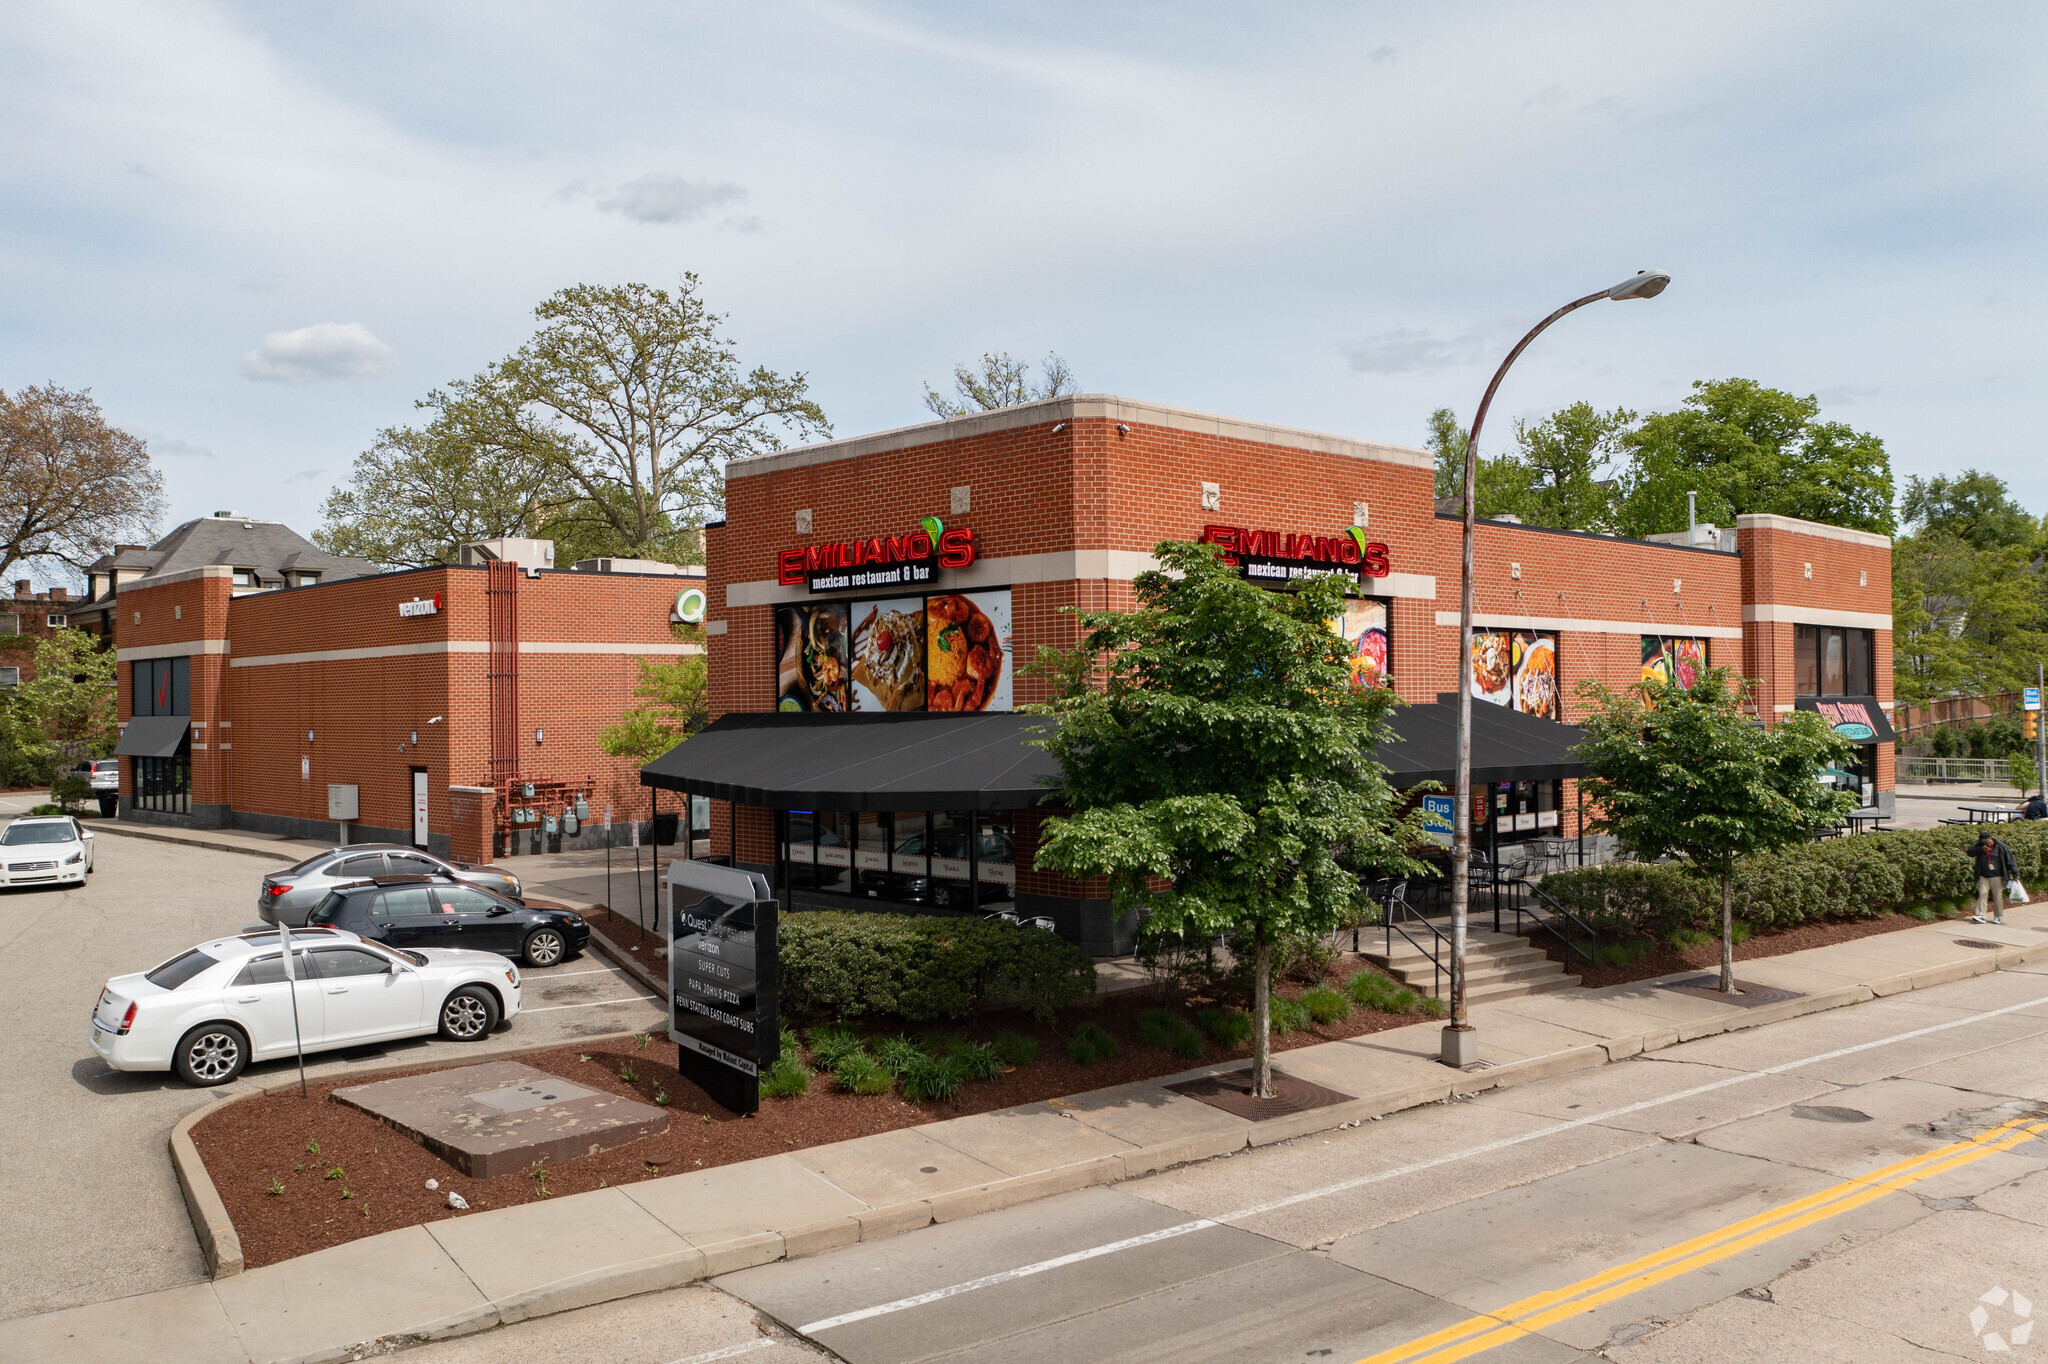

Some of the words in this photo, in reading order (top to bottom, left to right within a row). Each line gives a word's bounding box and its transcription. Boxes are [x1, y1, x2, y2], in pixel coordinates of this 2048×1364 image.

[812, 574, 849, 590] mexican
[852, 568, 900, 586] restaurant
[903, 566, 910, 581] &
[913, 565, 930, 580] bar
[1248, 562, 1287, 578] mexican
[399, 597, 437, 617] verizon
[1428, 800, 1450, 814] Bus
[687, 914, 707, 931] Quest
[707, 919, 747, 942] Dagnostics
[697, 940, 720, 955] verizon
[698, 959, 716, 974] SUPER
[716, 965, 730, 979] CUTS
[688, 978, 702, 992] PAPA
[703, 983, 722, 999] JOHN'S
[723, 990, 740, 1006] PIZZA
[676, 995, 689, 1009] PENN
[689, 1000, 710, 1017] STATION
[710, 1007, 723, 1021] EAST
[723, 1012, 739, 1028] COAST
[739, 1018, 754, 1034] SUBS
[716, 1049, 722, 1060] by
[738, 1058, 754, 1073] Capital
